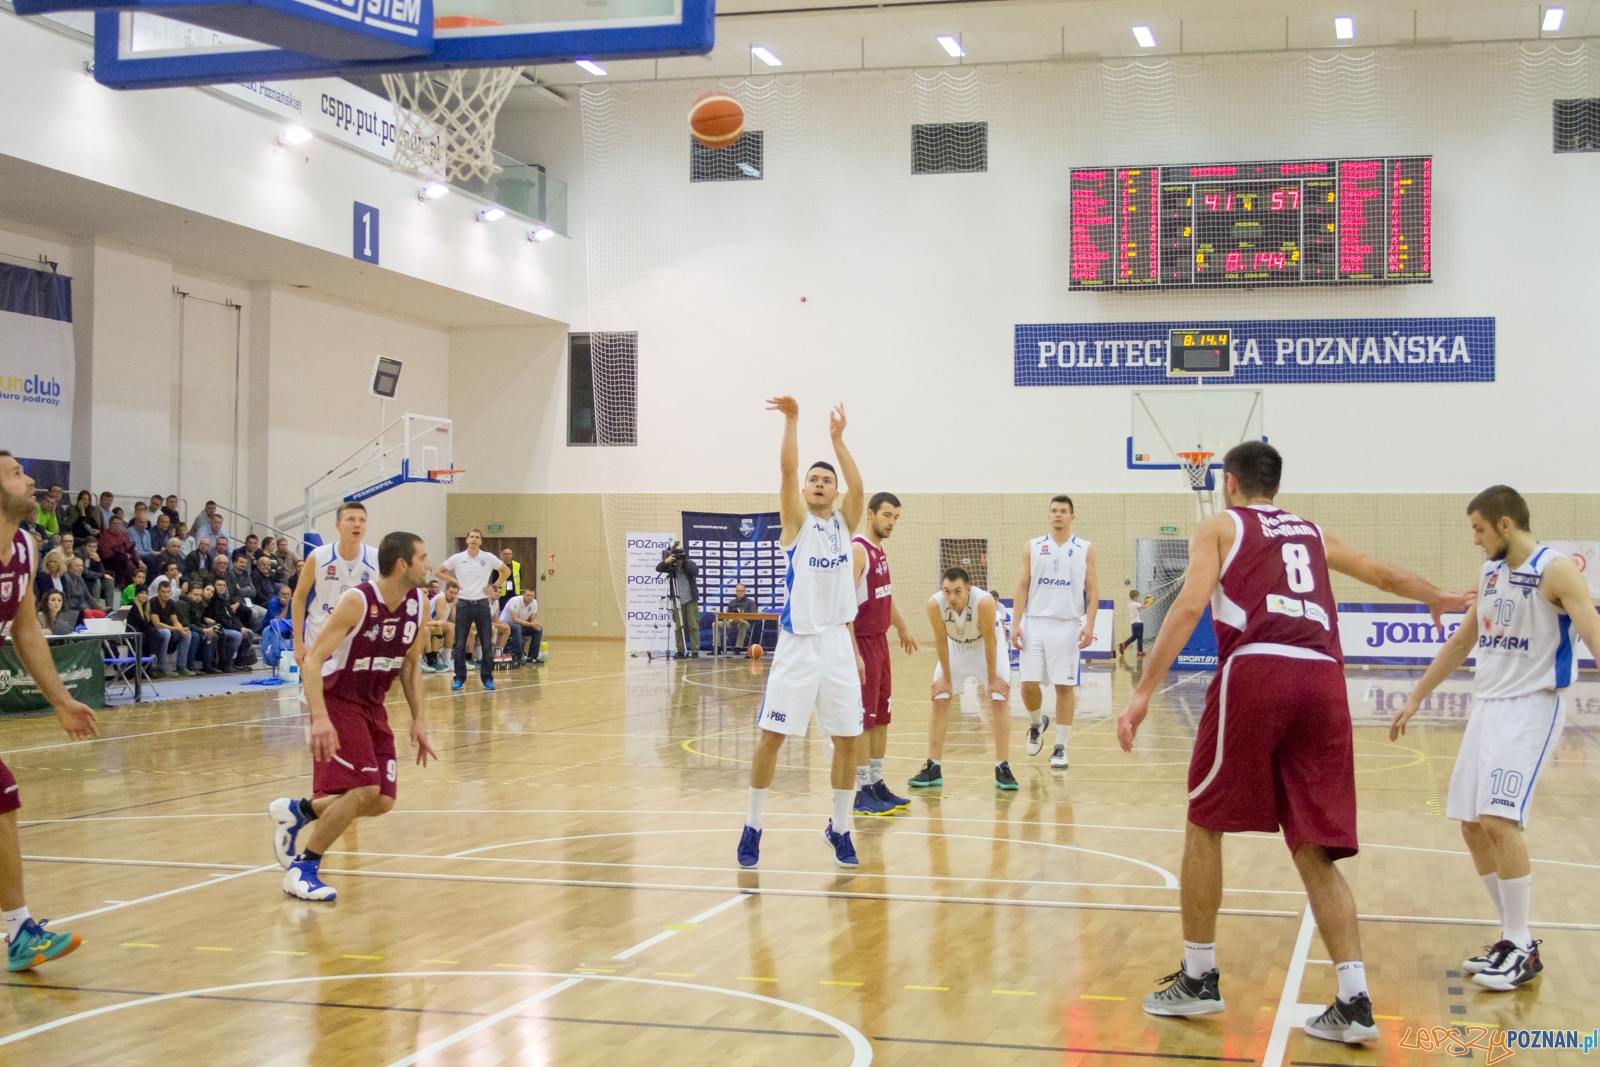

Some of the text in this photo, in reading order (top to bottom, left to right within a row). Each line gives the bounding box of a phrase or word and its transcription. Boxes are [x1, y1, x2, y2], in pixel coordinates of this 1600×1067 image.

[1186, 197, 1192, 207] 1
[1204, 193, 1234, 212] 41
[1244, 202, 1252, 210] 4
[1271, 190, 1300, 211] 57
[1326, 192, 1335, 203] 3
[362, 212, 372, 257] 1
[1183, 226, 1192, 237] 2
[1326, 223, 1335, 232] 4
[1196, 253, 1204, 263] 0
[1291, 250, 1300, 261] 2
[1275, 330, 1471, 366] POZNAŃSKA
[352, 480, 394, 500] PESMENPOL
[1053, 559, 1060, 573] 1
[1281, 542, 1315, 594] 8
[1494, 598, 1515, 627] 10
[402, 621, 418, 645] 9
[770, 710, 786, 722] PBG
[386, 759, 397, 782] 9
[1491, 768, 1523, 798] 10
